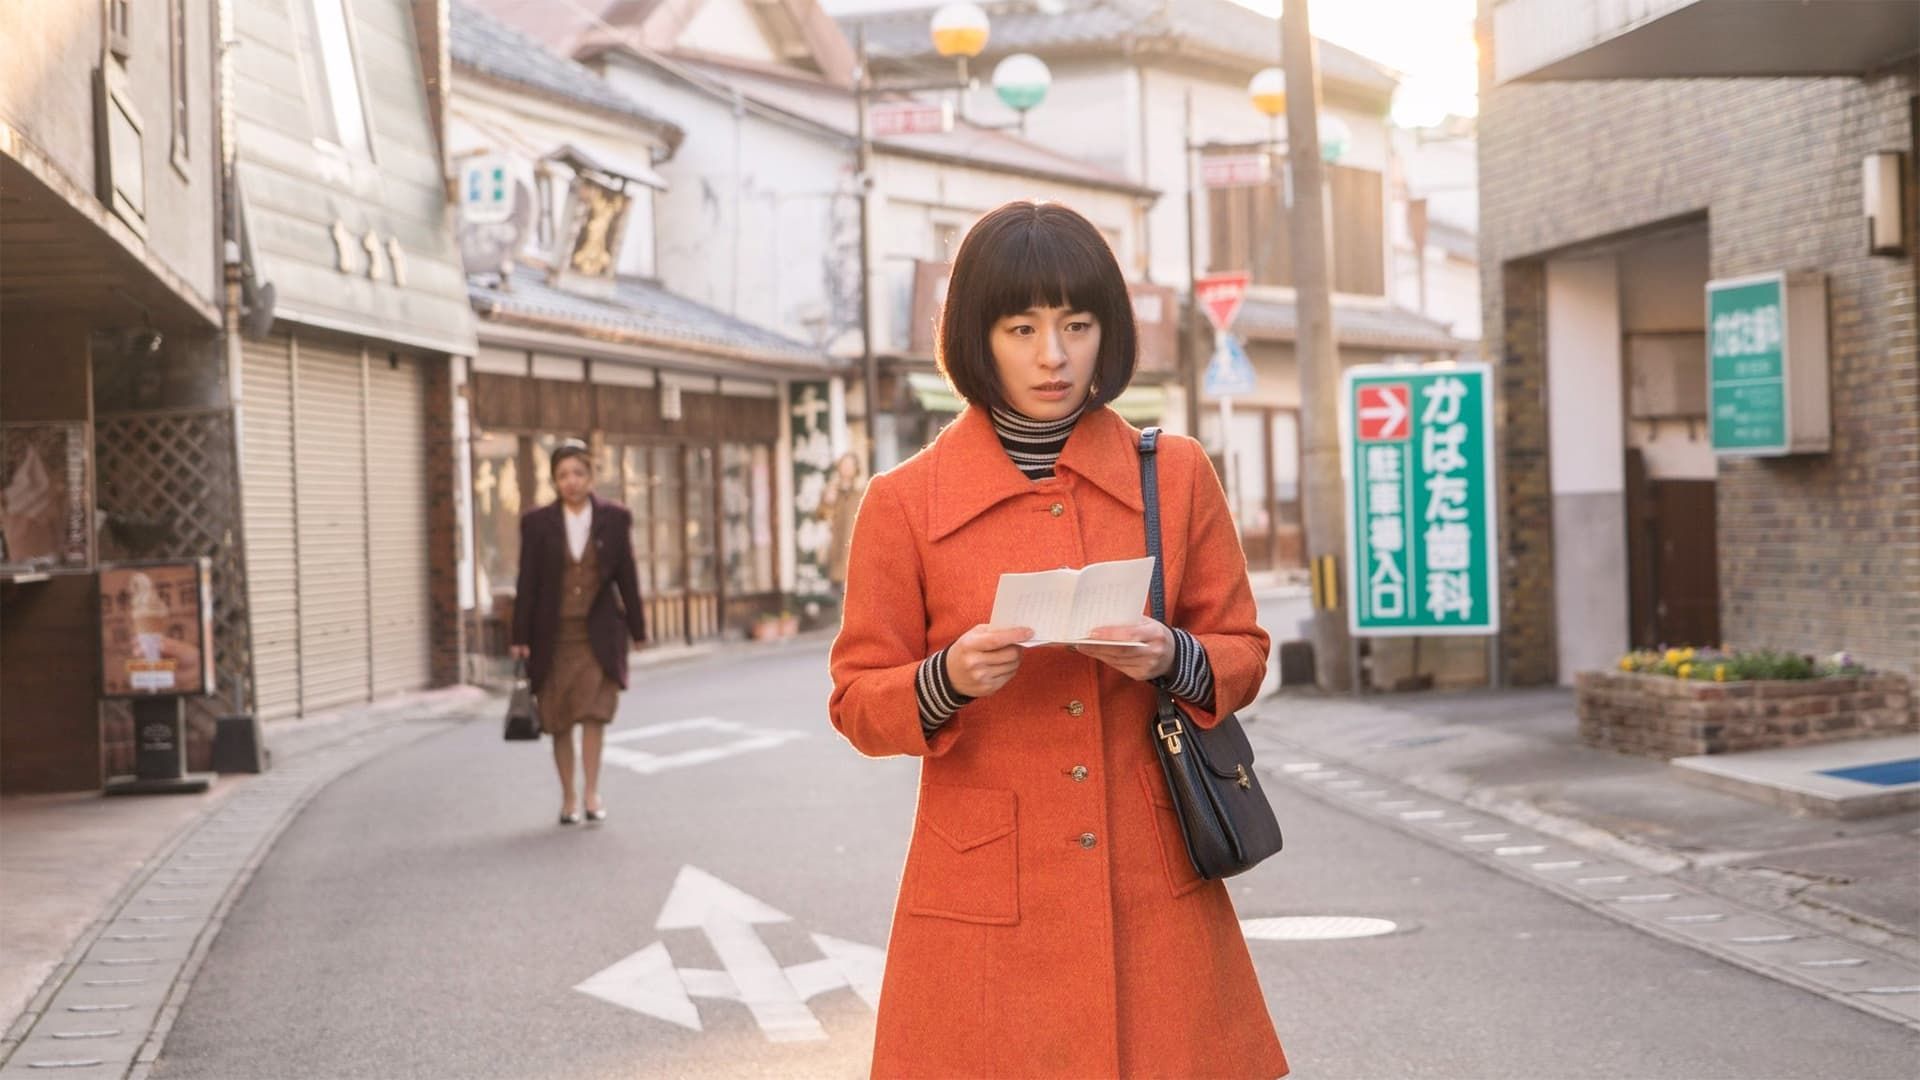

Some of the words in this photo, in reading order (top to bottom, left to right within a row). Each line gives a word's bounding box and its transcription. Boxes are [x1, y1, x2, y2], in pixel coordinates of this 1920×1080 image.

[1367, 446, 1405, 618] 駐車場入口
[1421, 377, 1472, 621] かばた歯科
